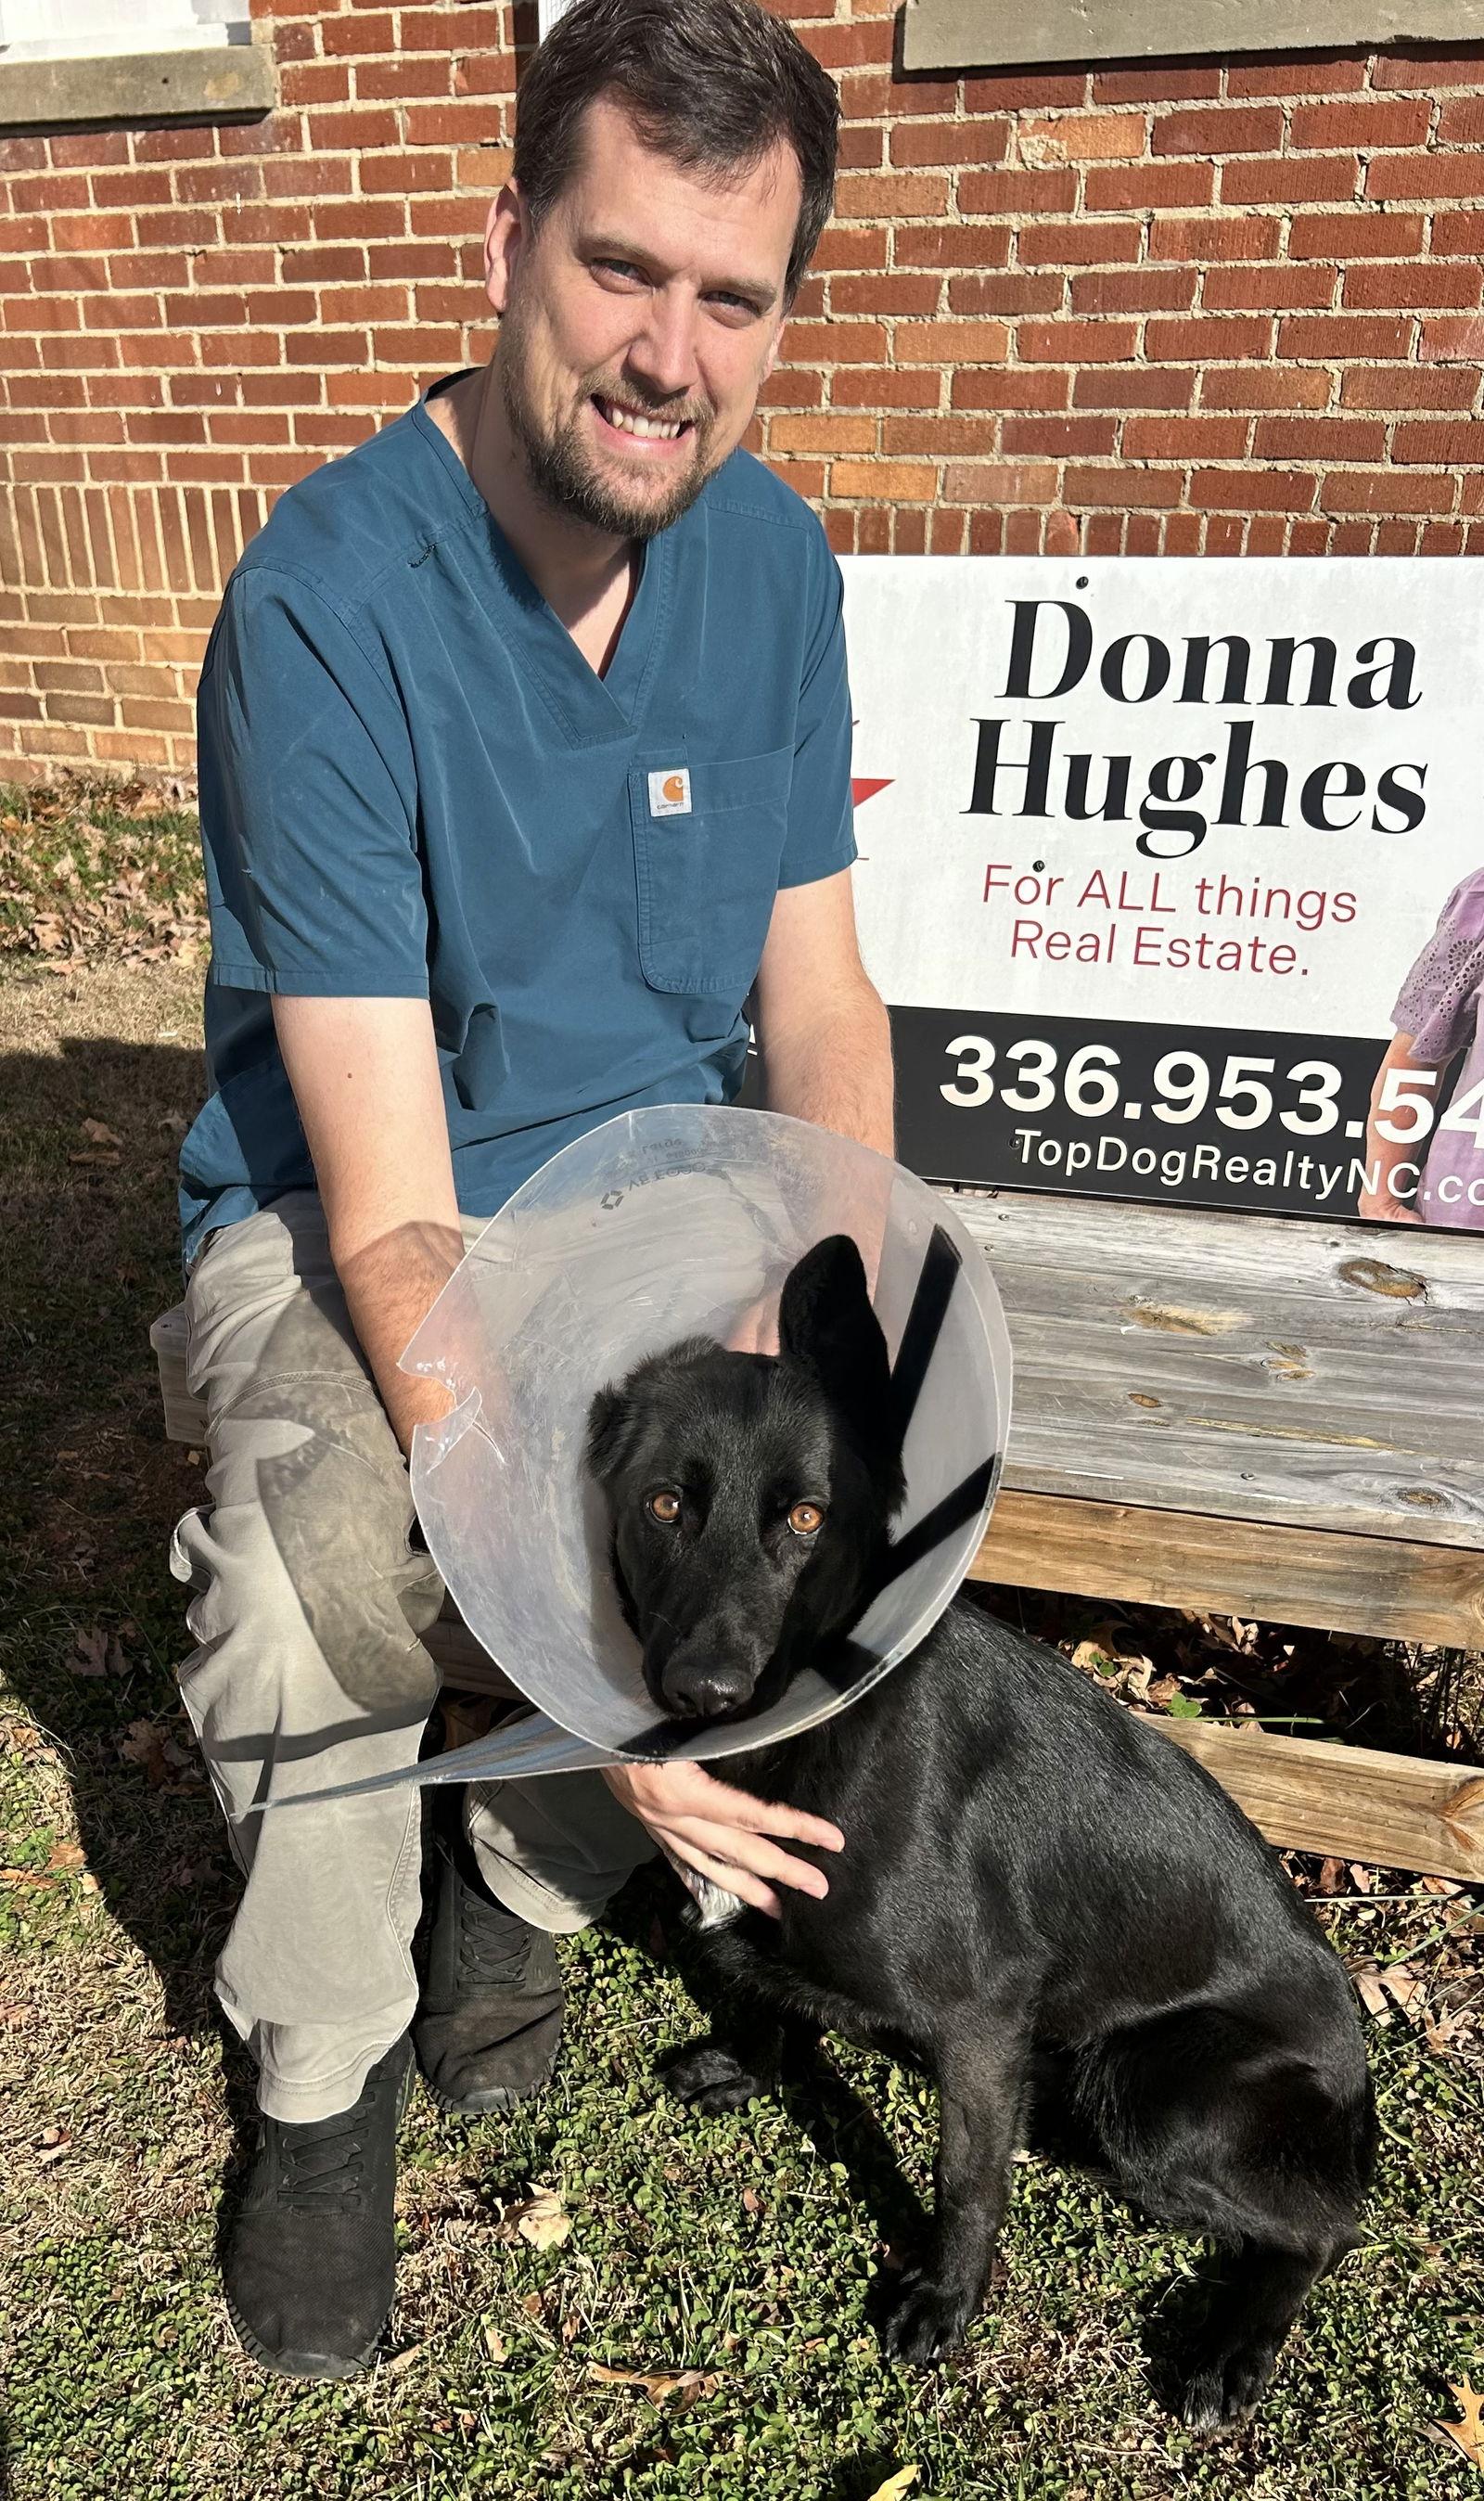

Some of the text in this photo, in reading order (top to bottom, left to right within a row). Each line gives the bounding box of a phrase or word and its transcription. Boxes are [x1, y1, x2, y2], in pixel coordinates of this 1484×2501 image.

[993, 599, 1423, 711] Donna
[958, 718, 1428, 860] Hughes
[982, 864, 1357, 930] For ALL things
[1011, 919, 1310, 976] Real Estate.
[940, 1035, 1484, 1149] 336.953.54
